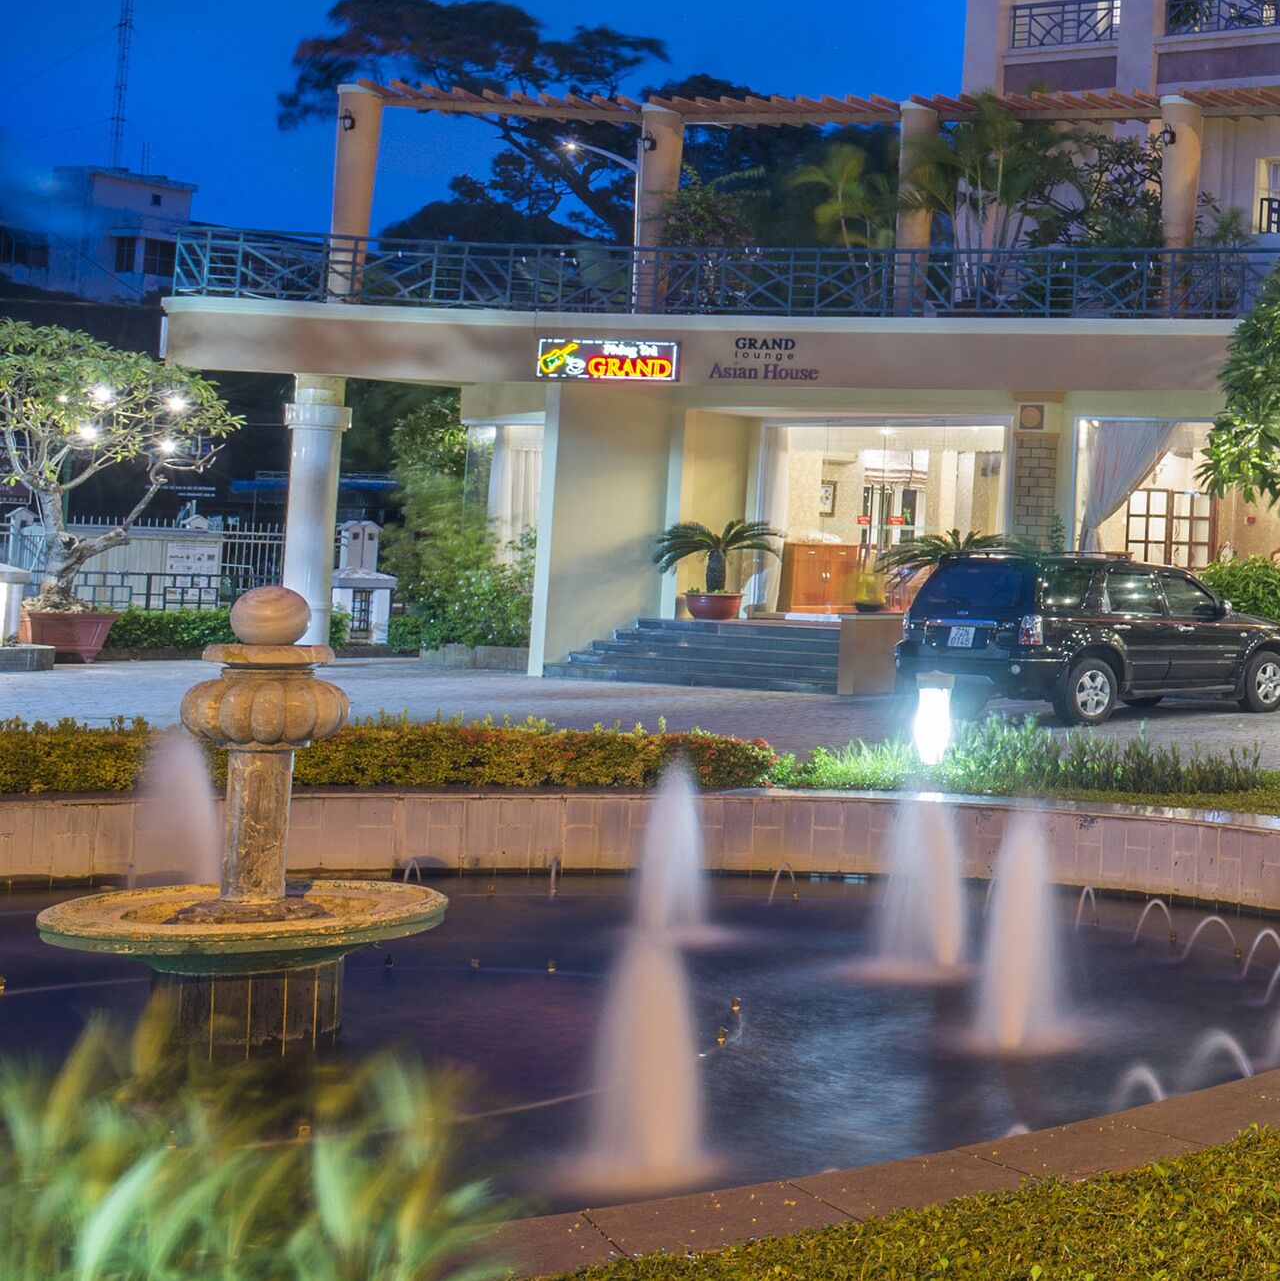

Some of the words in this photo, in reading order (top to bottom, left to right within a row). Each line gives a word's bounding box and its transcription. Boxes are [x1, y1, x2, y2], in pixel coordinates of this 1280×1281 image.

[735, 337, 796, 350] GRAND
[734, 351, 795, 361] lounge
[587, 357, 672, 378] GRAND
[710, 362, 758, 379] Asian
[763, 363, 819, 380] House
